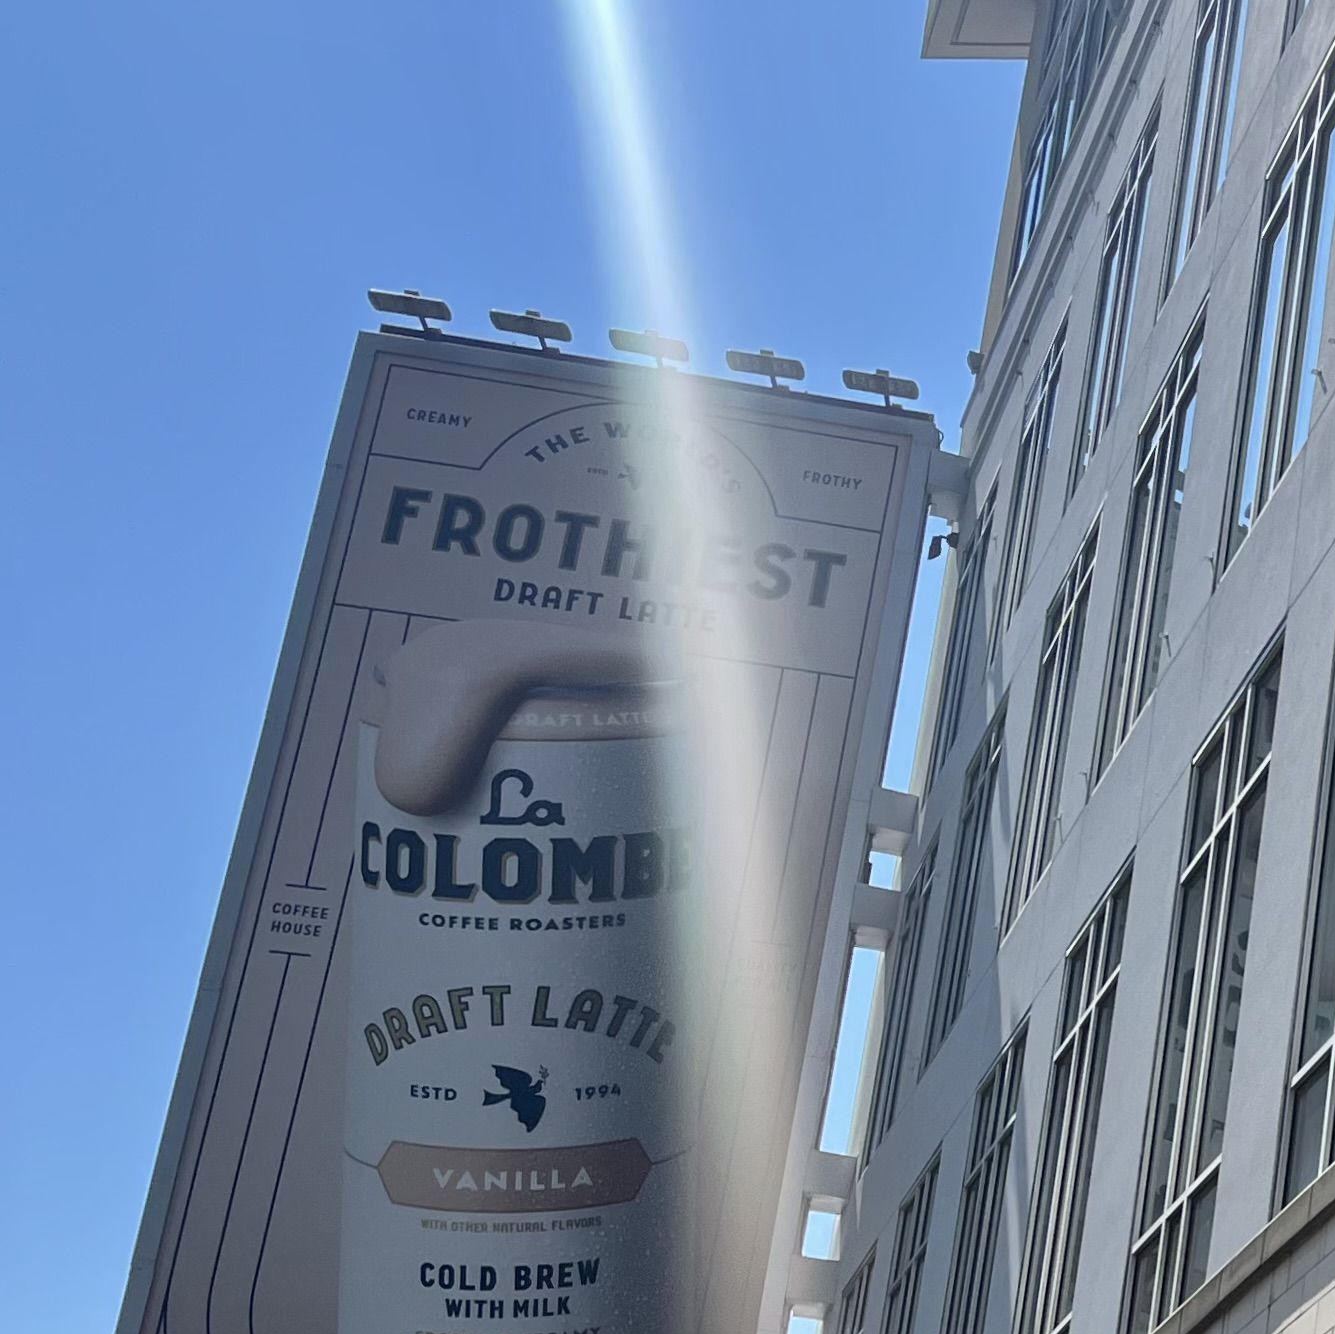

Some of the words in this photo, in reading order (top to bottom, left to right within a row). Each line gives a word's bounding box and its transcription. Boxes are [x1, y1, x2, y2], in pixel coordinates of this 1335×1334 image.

[406, 407, 473, 429] CREAMY
[524, 425, 591, 464] THE
[802, 469, 864, 491] FROTHY
[380, 484, 848, 609] FROTHEST
[493, 576, 605, 617] DRAFT
[479, 768, 566, 827] La
[272, 901, 330, 920] COFFEE
[418, 913, 500, 932] COFFEE
[510, 912, 627, 932] ROASTERS
[270, 920, 323, 939] HOUSE
[363, 984, 512, 1067] DRAFT
[531, 985, 676, 1064] LATTE
[410, 1083, 458, 1101] ESTD
[573, 1083, 622, 1101] 1994
[432, 1166, 594, 1191] VANILLA
[421, 1218, 448, 1232] WITH
[451, 1220, 489, 1233] OTHER
[493, 1220, 547, 1233] NATURAL
[552, 1215, 602, 1232] FLAVORS
[420, 1262, 497, 1292] COLD
[514, 1257, 600, 1291] BREW
[445, 1298, 504, 1319] WITH
[512, 1295, 571, 1318] MILK
